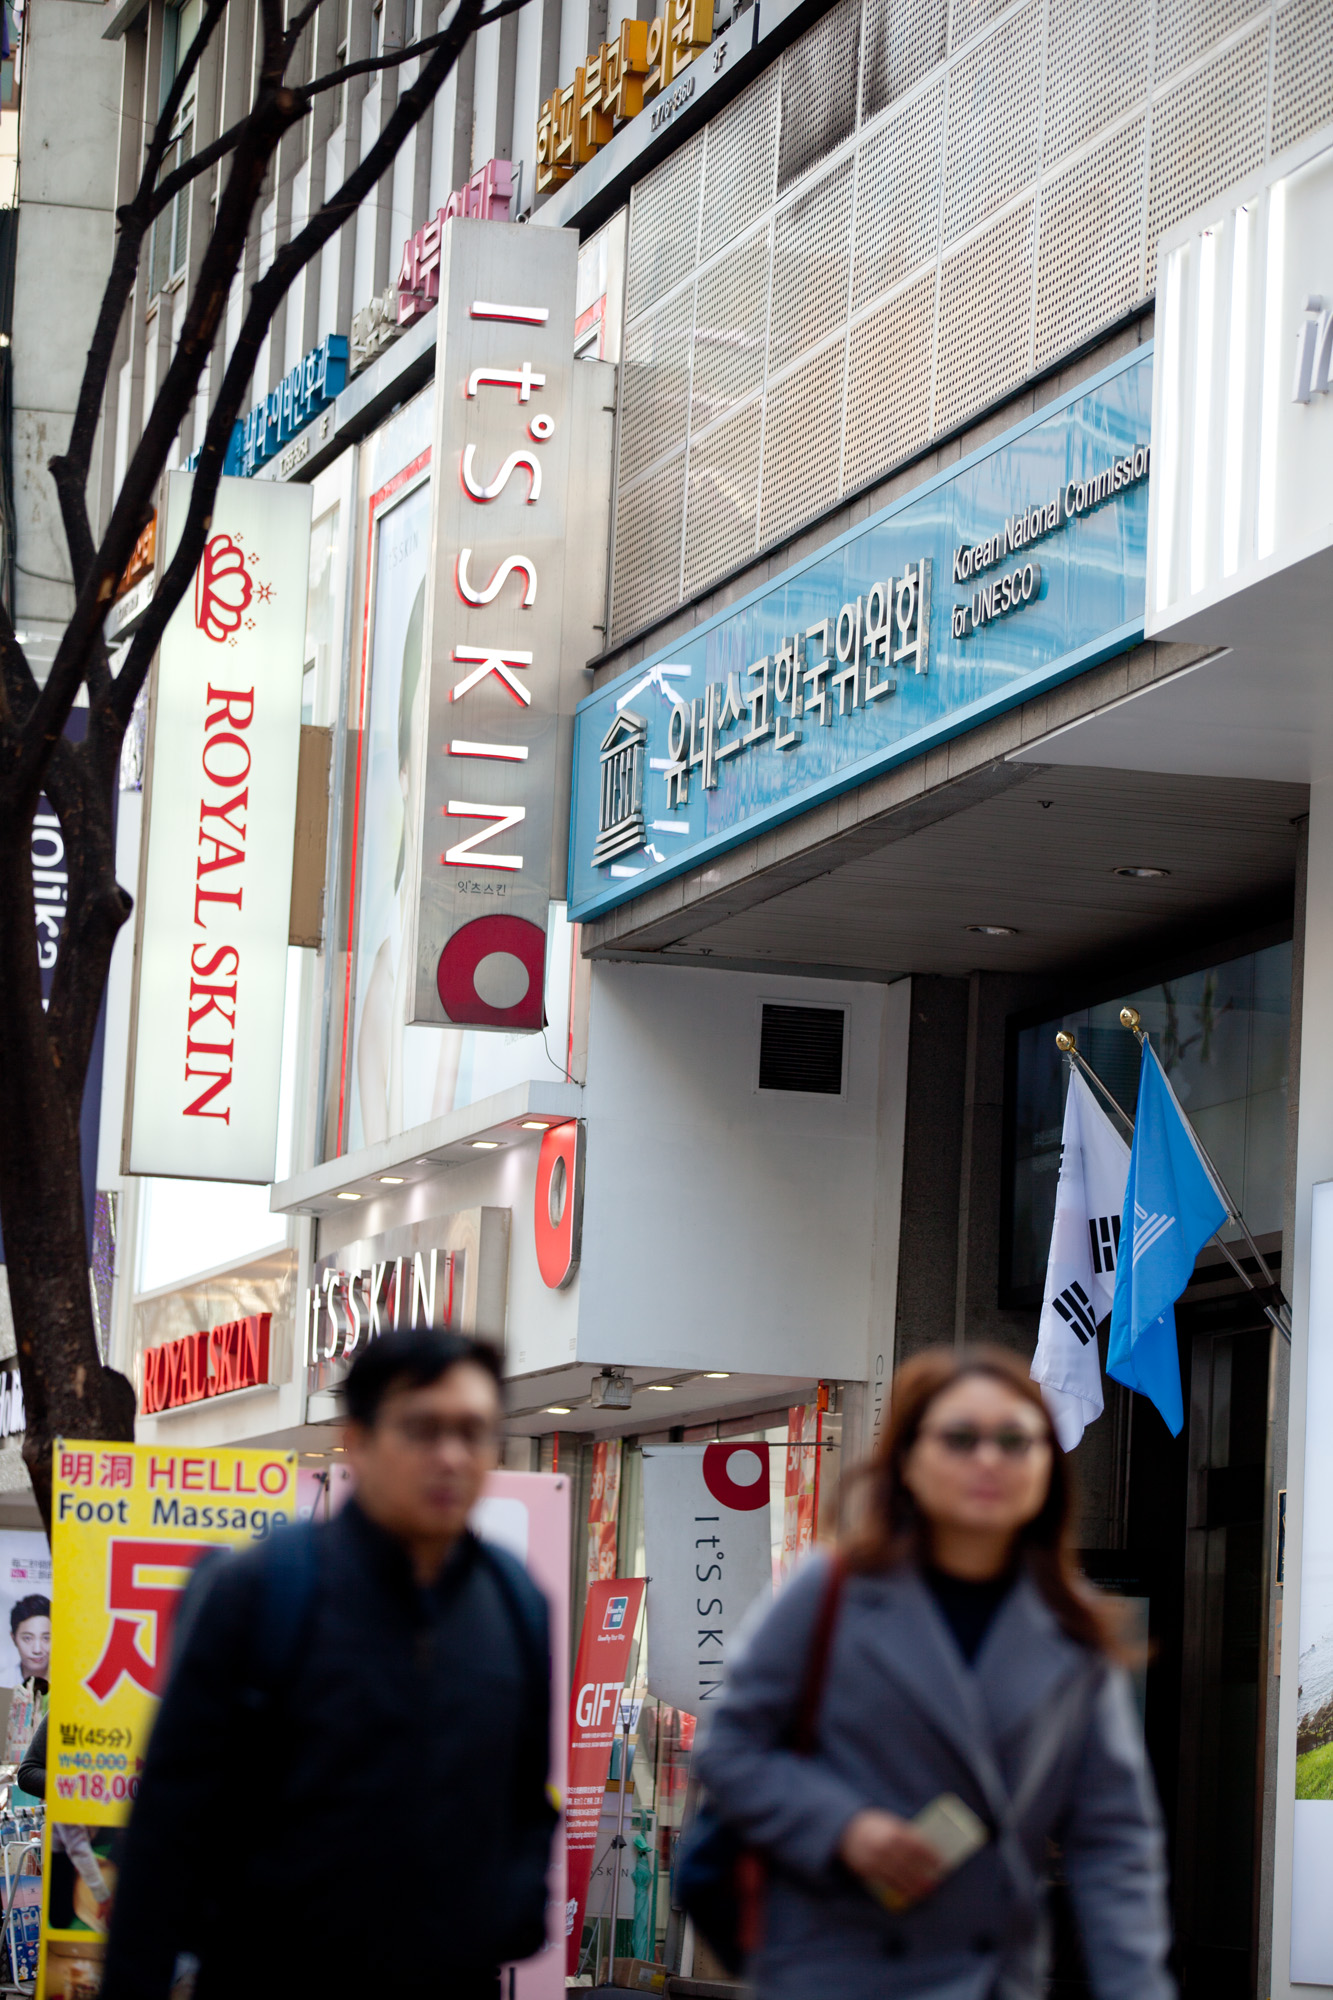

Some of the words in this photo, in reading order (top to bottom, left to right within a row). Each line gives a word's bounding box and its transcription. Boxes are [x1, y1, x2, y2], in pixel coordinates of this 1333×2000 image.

[953, 533, 1003, 585] Korean
[1003, 486, 1065, 555] National
[951, 603, 971, 639] for
[971, 562, 1037, 628] UNESCO
[442, 547, 539, 875] SKIN
[194, 682, 256, 930] ROYAL
[31, 813, 69, 969] olika
[182, 942, 241, 1127] SKIN
[141, 1331, 209, 1415] ROYAL
[208, 1312, 273, 1397] SKIN
[58, 1494, 128, 1524] Foot
[152, 1498, 289, 1540] Massage
[60, 1453, 134, 1489] 明洞
[149, 1457, 289, 1495] HELLO
[576, 1681, 625, 1728] GIFT
